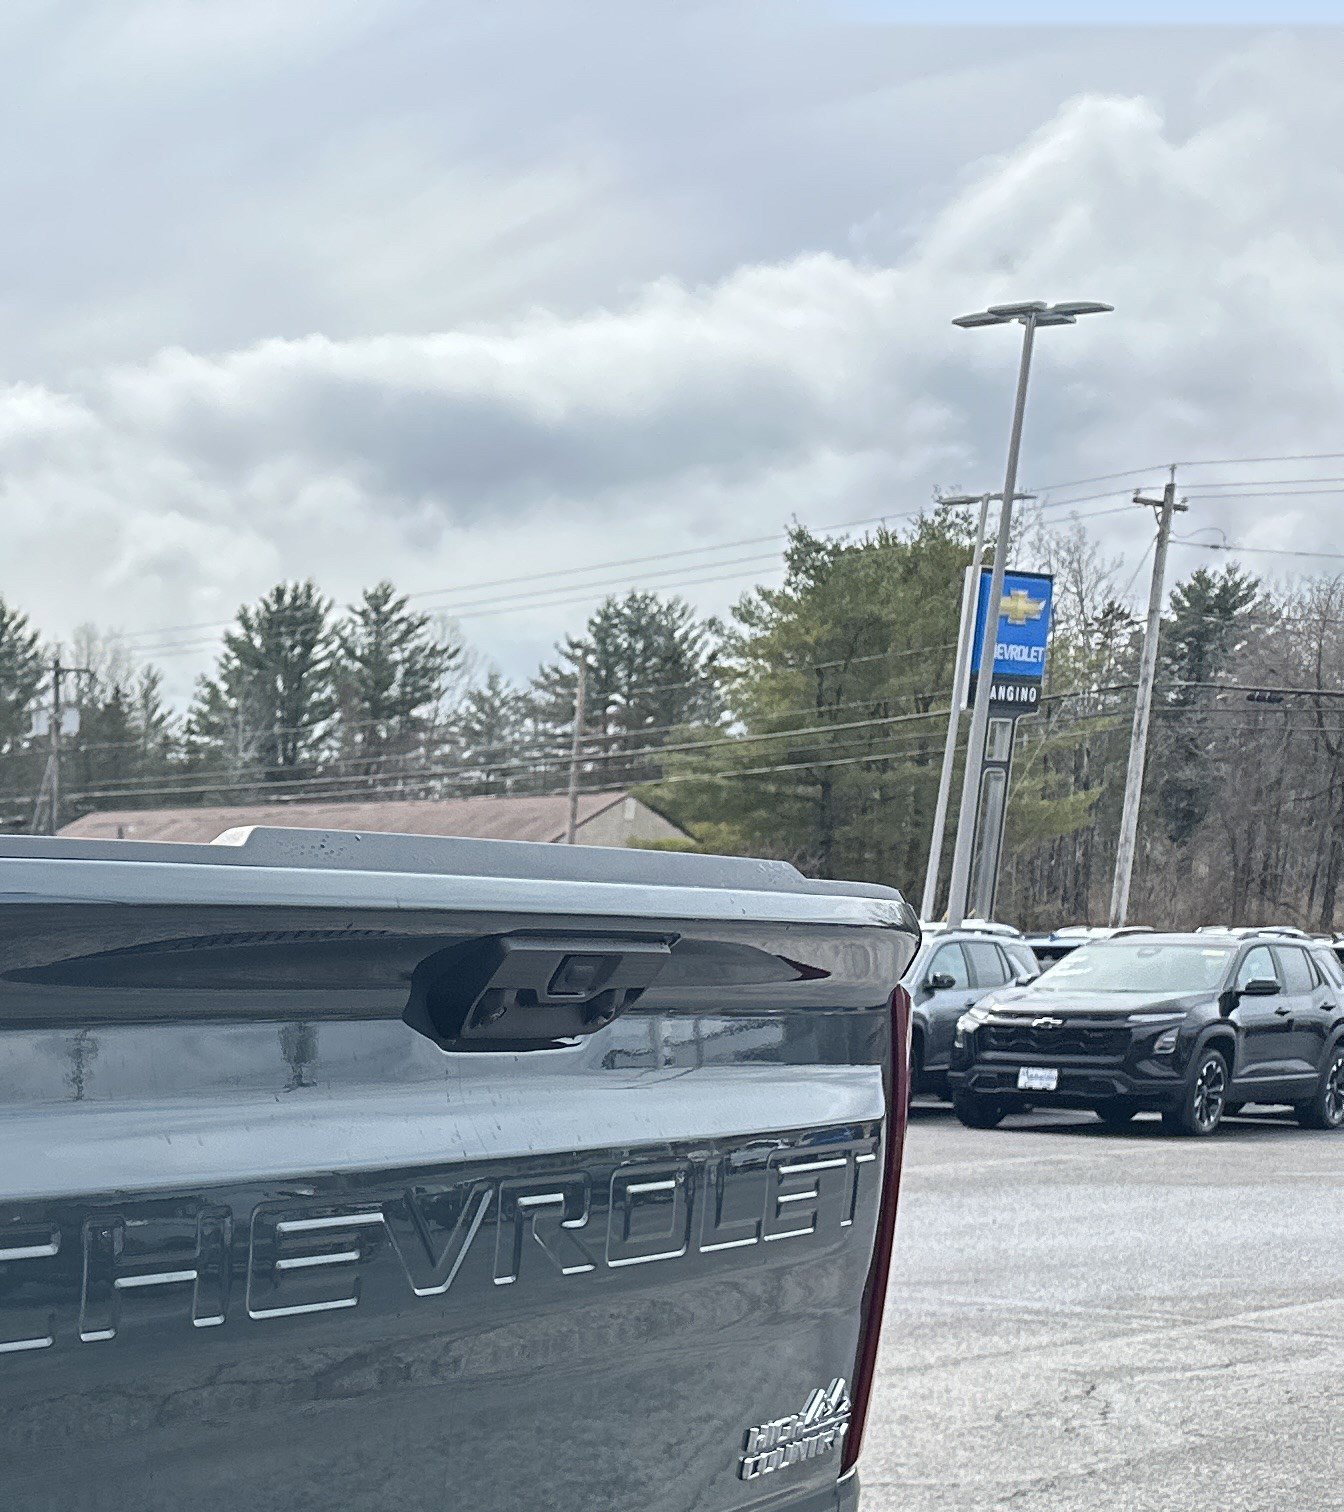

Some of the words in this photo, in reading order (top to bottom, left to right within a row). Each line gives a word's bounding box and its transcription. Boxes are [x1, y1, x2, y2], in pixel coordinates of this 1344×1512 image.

[994, 643, 1045, 663] EVROLET
[989, 685, 1037, 703] ANGINO
[741, 1422, 850, 1480] COUNTRY
